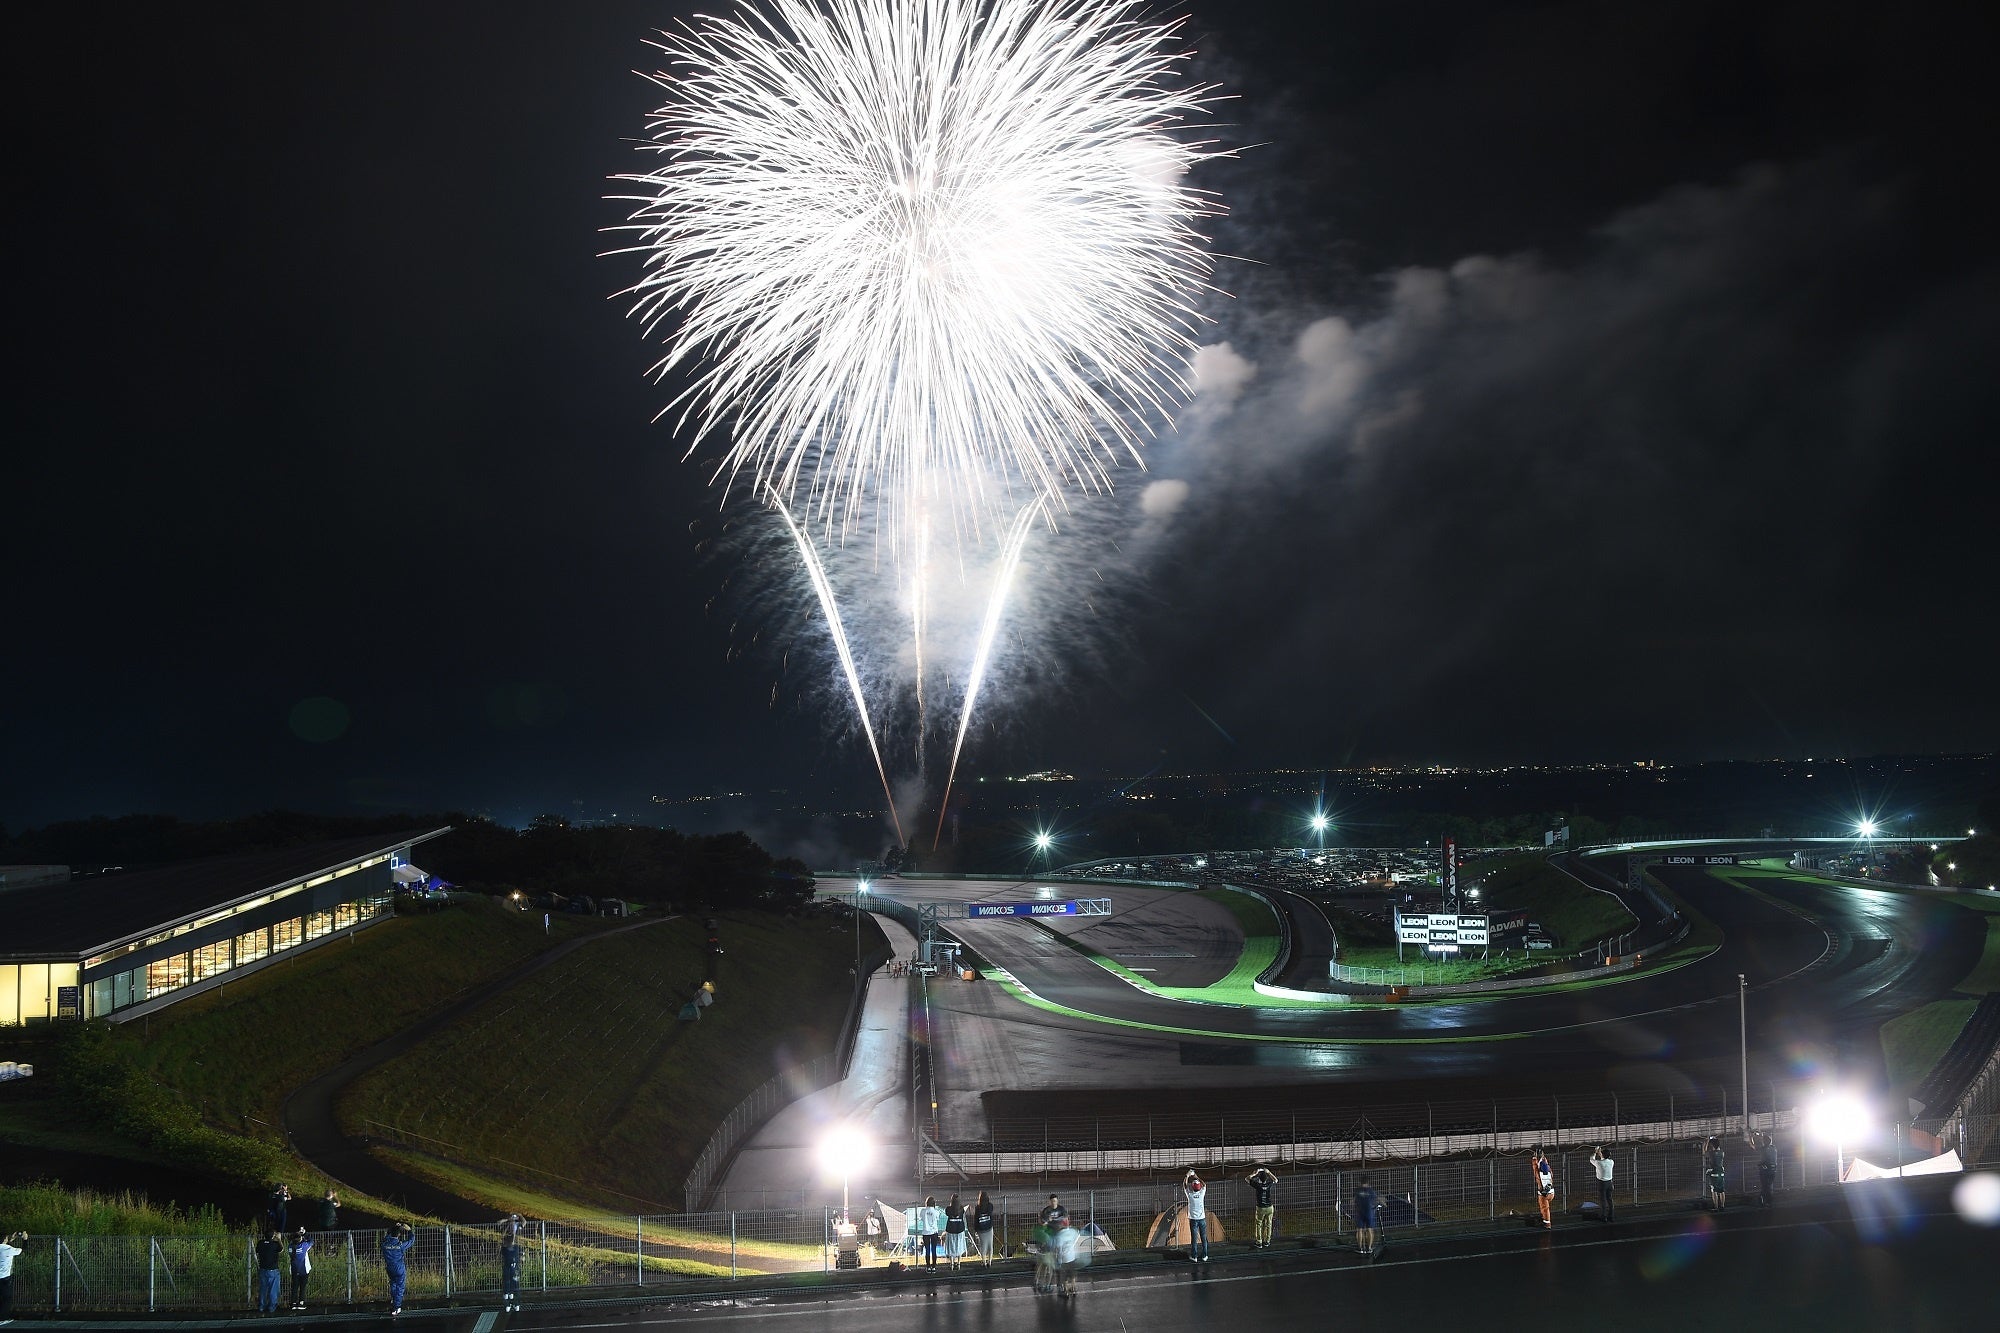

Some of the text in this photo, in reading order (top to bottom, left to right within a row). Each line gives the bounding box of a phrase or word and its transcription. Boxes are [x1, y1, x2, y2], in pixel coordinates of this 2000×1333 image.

[1667, 856, 1733, 864] LEON LEON
[1401, 917, 1428, 926] LEON
[1458, 919, 1485, 927] LEON
[1489, 919, 1524, 933] ADVAN
[1430, 933, 1457, 941] LEON
